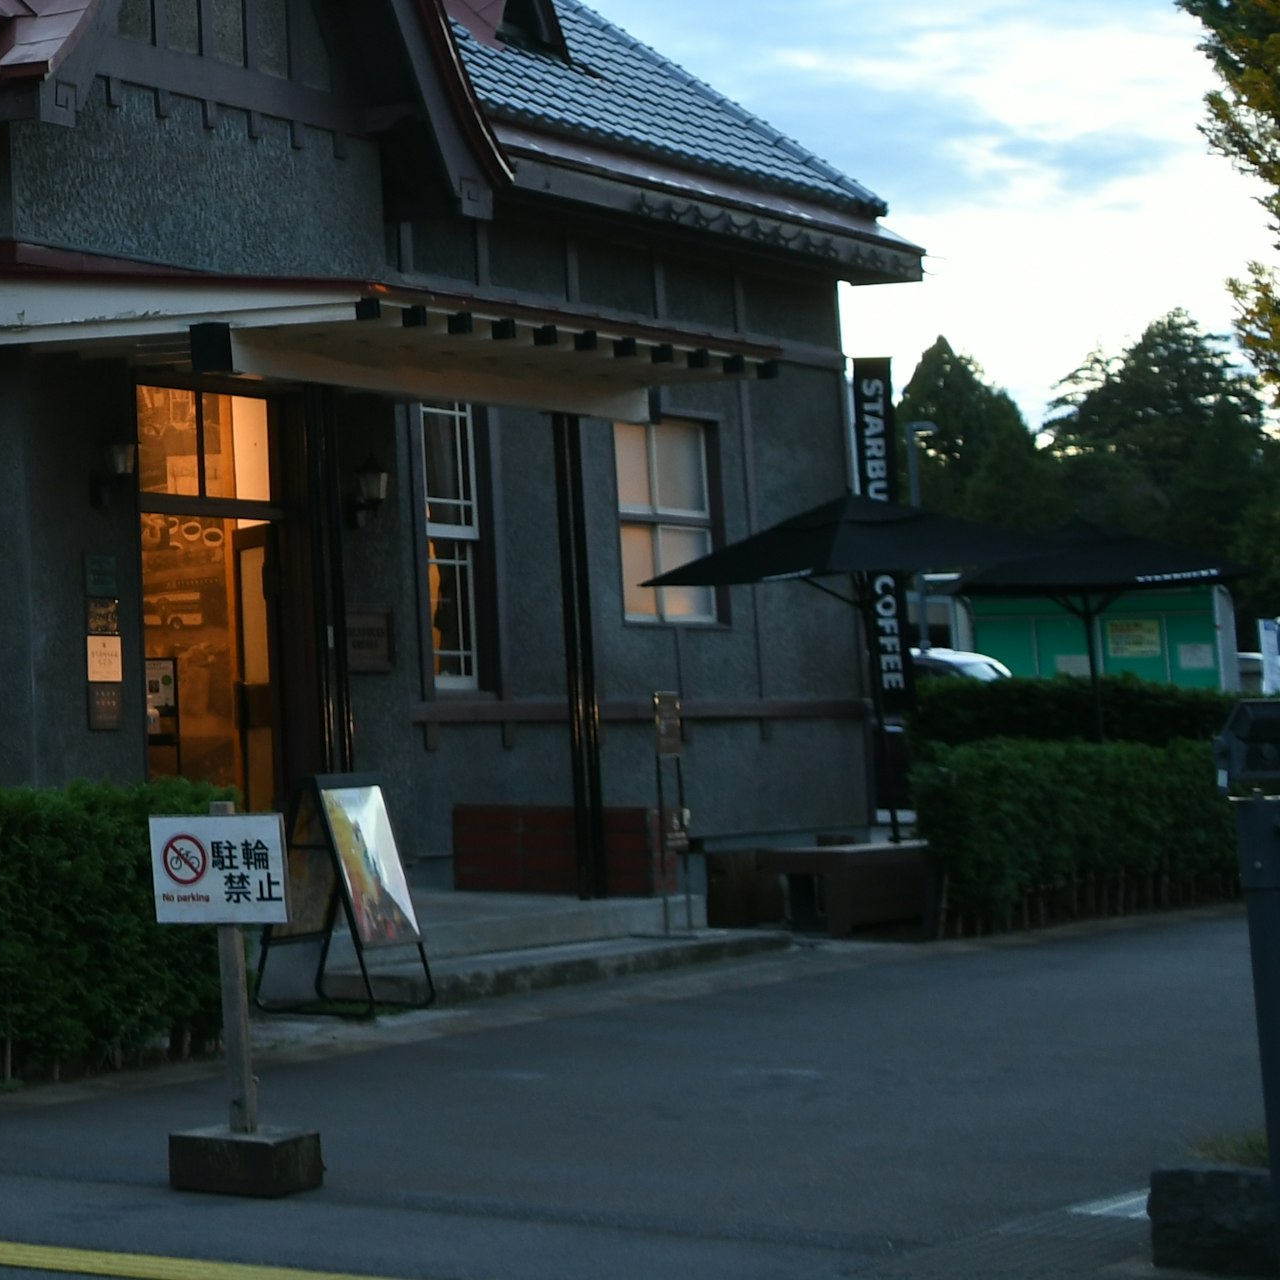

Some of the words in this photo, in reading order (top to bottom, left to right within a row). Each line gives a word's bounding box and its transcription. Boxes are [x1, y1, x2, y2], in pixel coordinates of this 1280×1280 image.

[861, 377, 889, 502] STARBU
[873, 574, 905, 691] COFFEE
[210, 839, 269, 871] 駐輪
[162, 893, 175, 903] No
[177, 892, 210, 903] parking
[224, 872, 283, 904] 禁止
